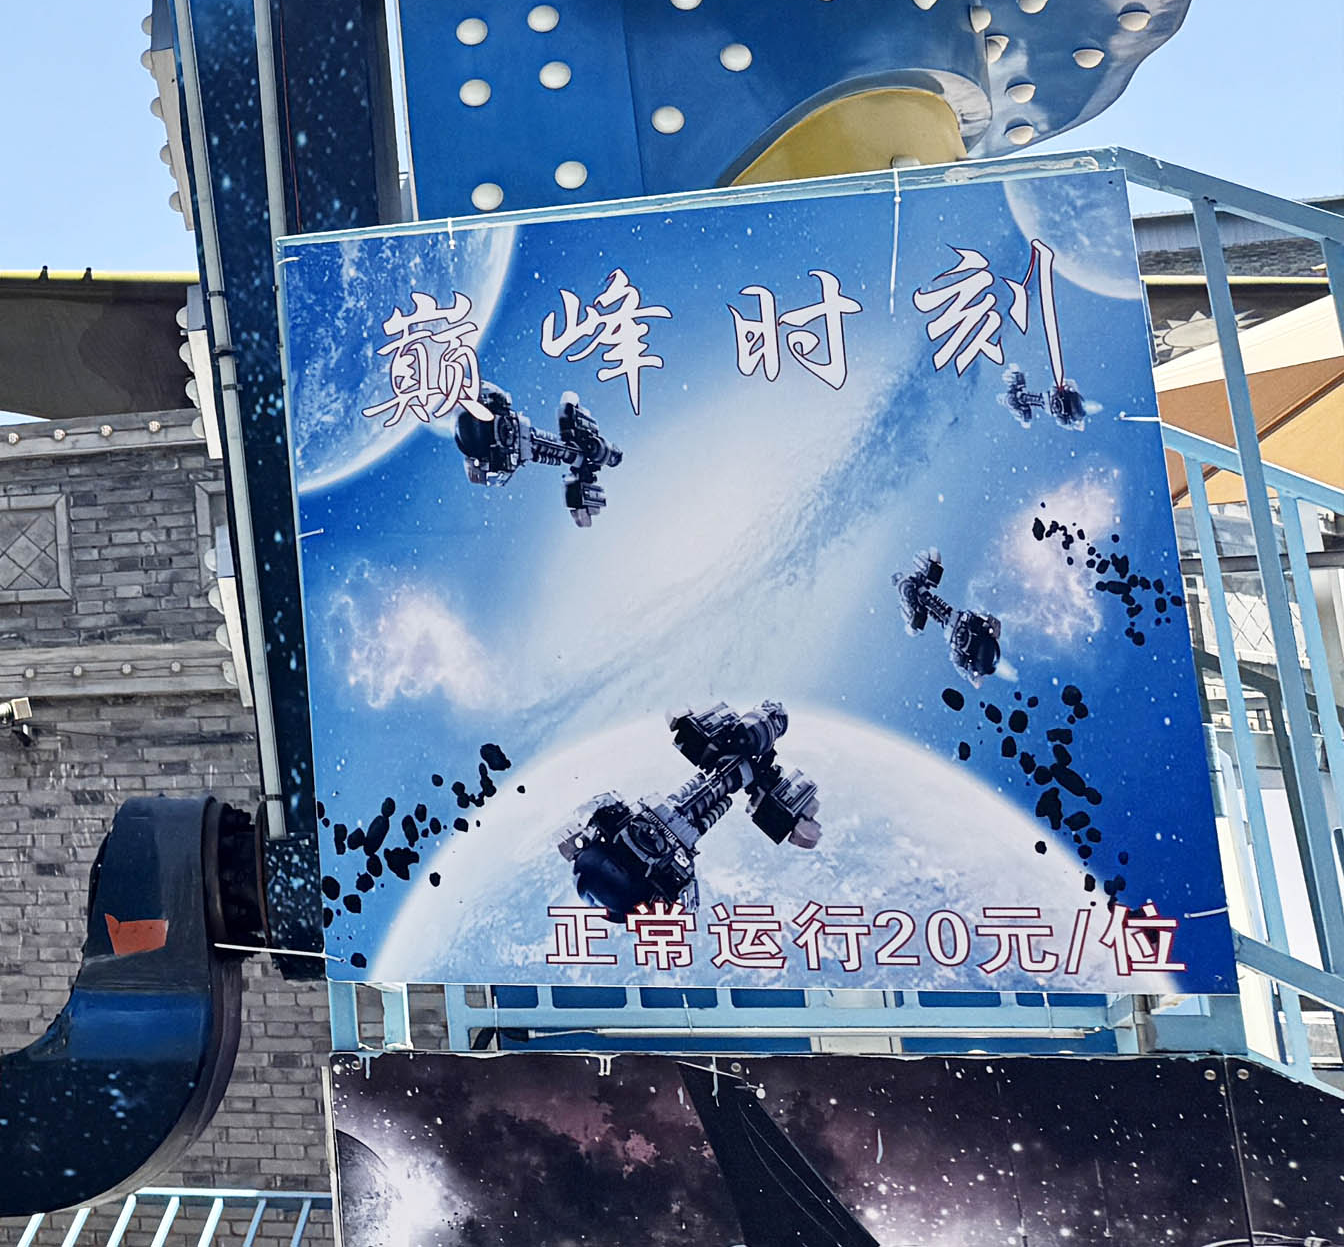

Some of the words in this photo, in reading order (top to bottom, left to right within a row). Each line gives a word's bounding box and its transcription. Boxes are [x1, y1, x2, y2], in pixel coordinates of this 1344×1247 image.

[362, 238, 1064, 429] 巅峰时刻
[546, 900, 1187, 977] 正常运行20元/位
